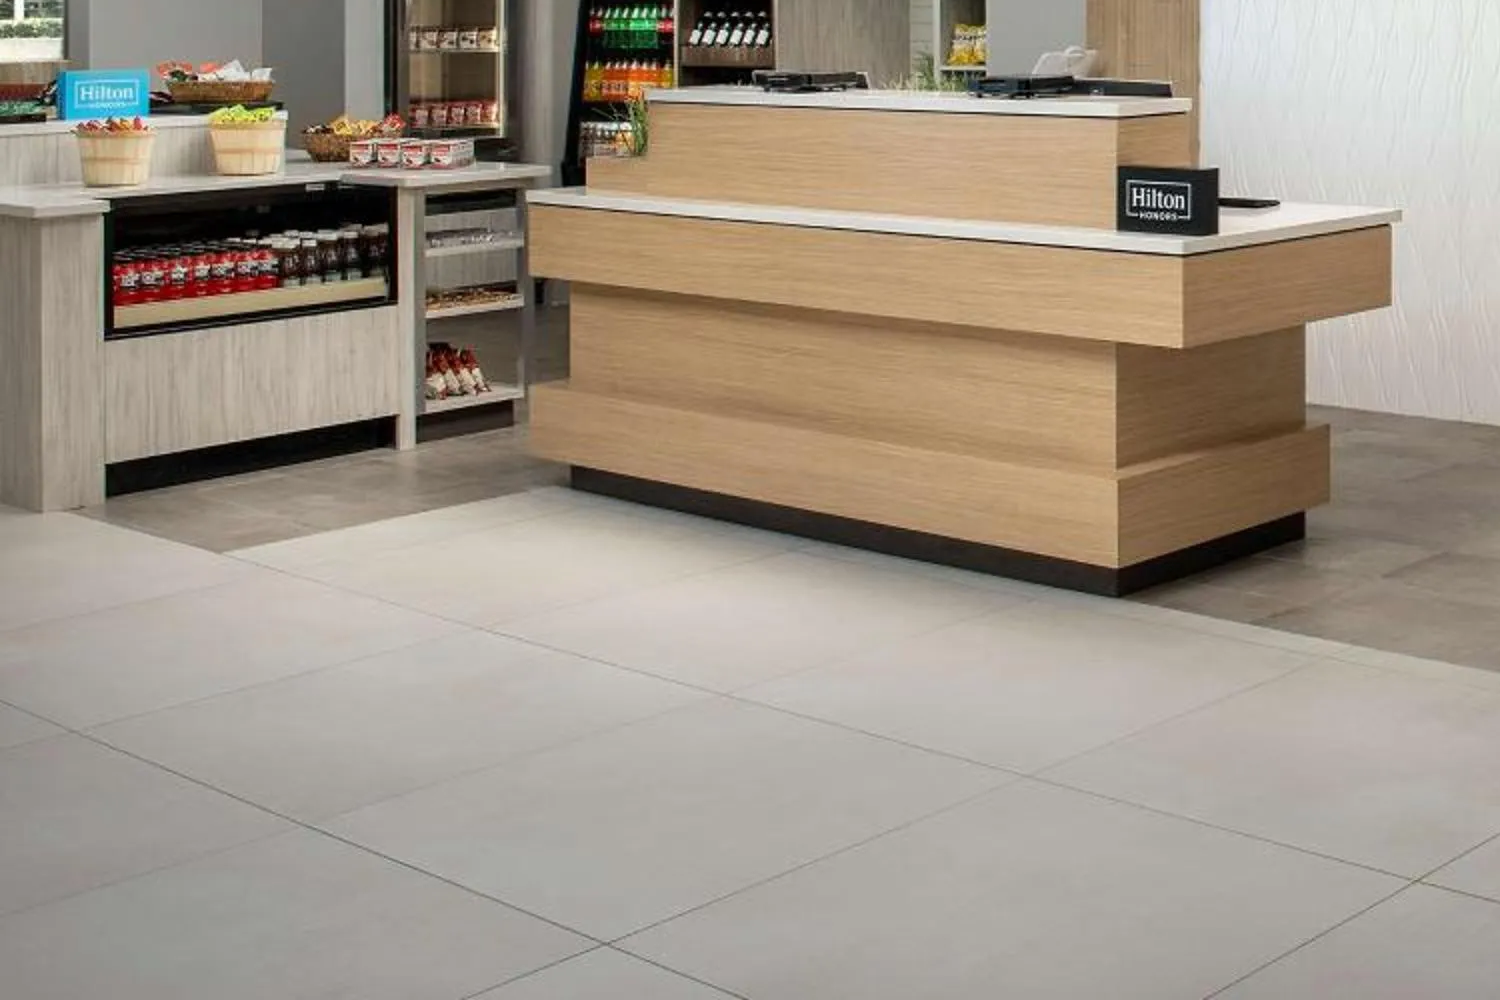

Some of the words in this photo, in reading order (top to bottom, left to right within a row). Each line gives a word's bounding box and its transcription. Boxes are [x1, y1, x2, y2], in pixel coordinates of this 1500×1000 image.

[80, 85, 134, 101] Hilton
[1131, 187, 1185, 210] Hilton
[1139, 211, 1178, 221] HONORS
